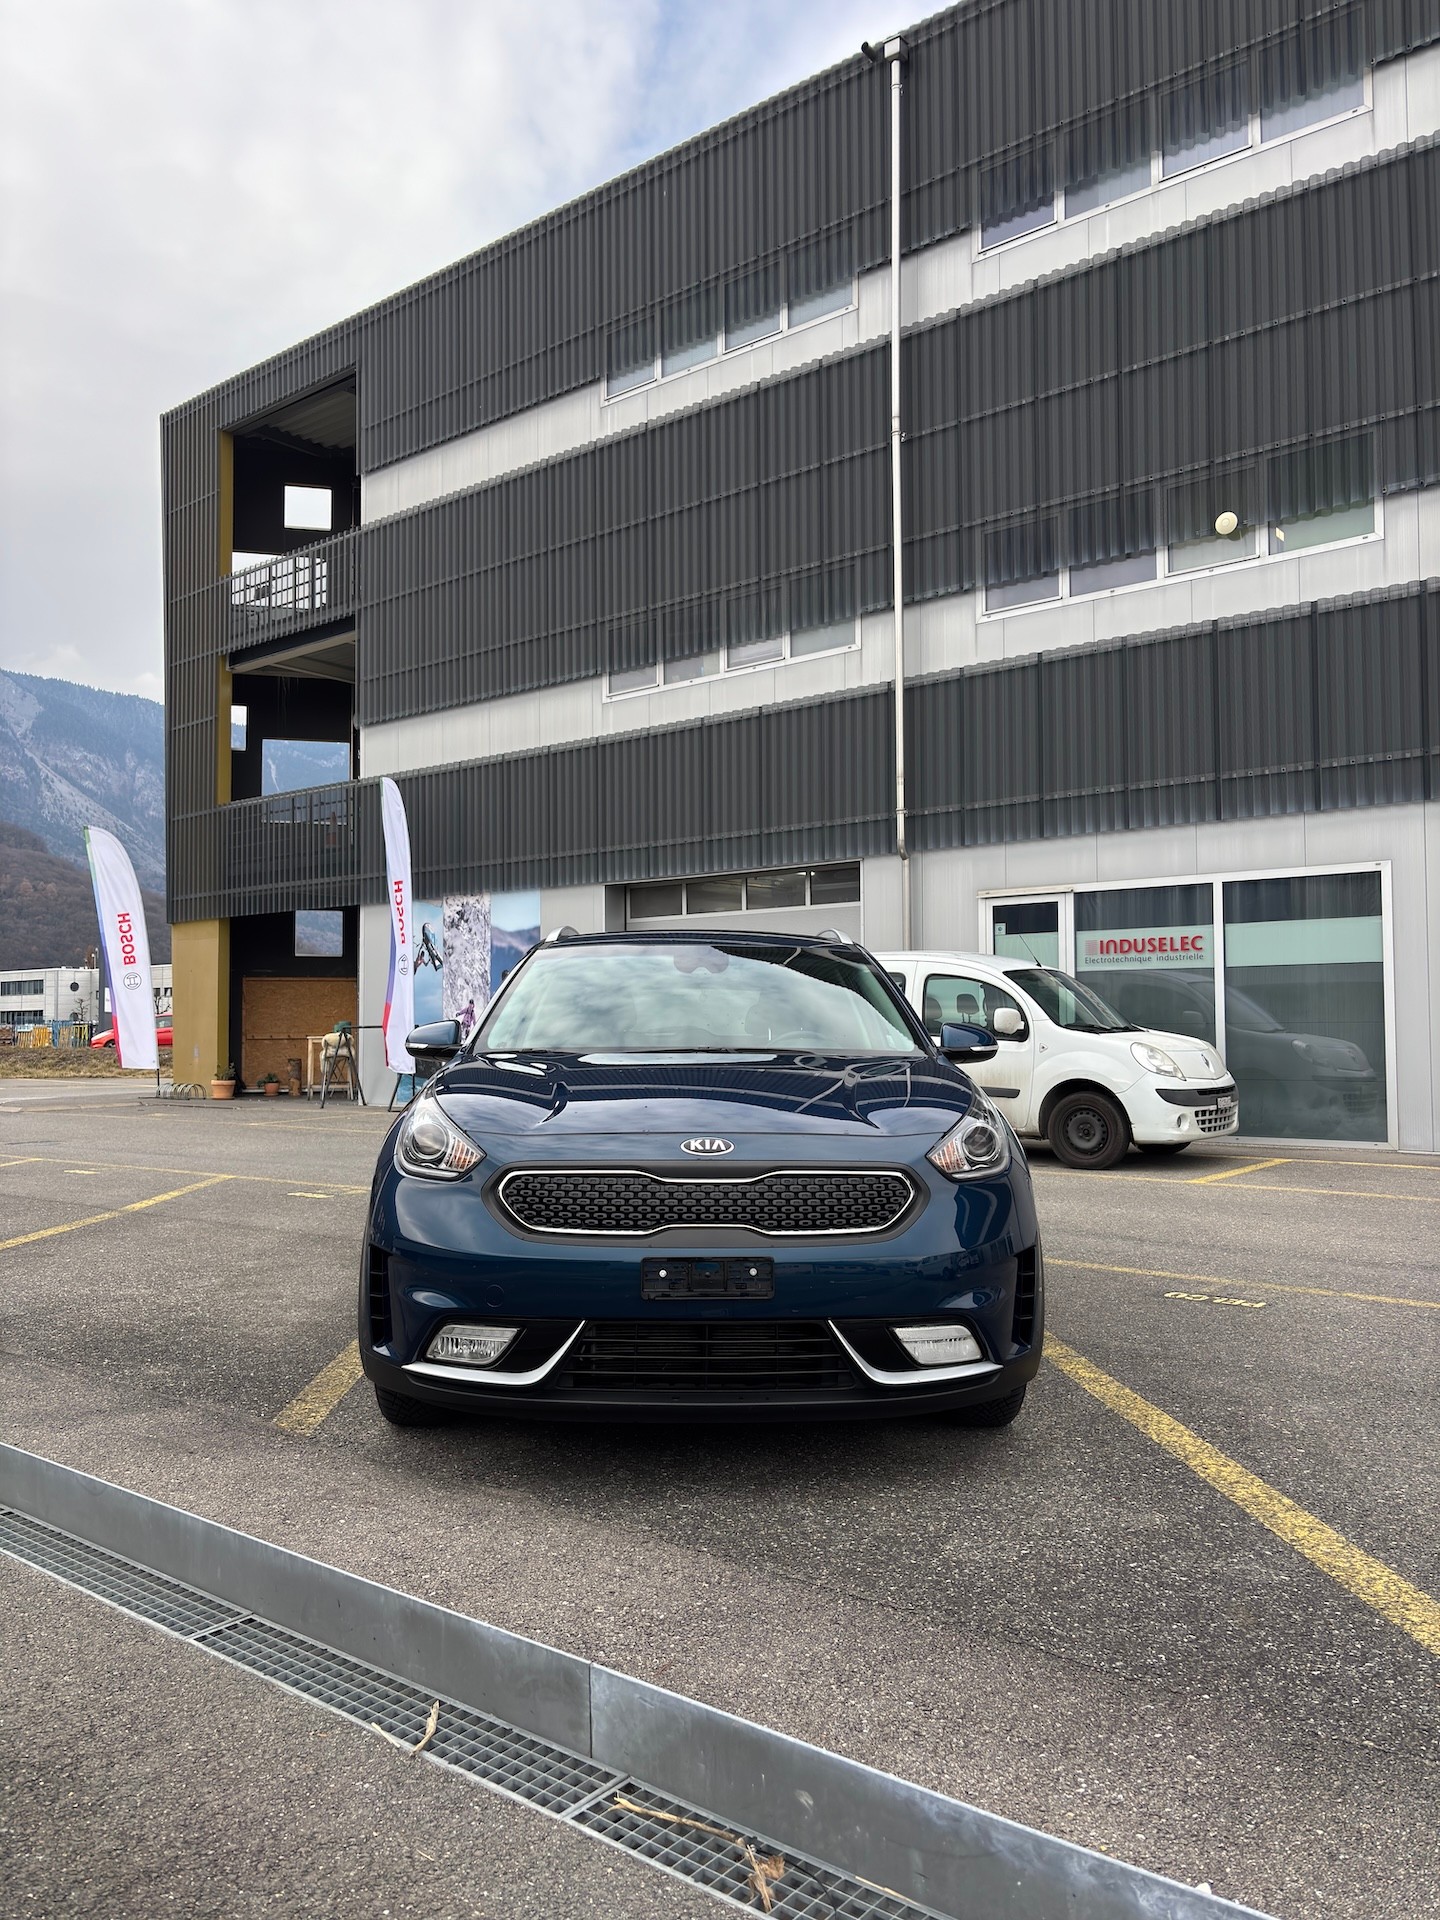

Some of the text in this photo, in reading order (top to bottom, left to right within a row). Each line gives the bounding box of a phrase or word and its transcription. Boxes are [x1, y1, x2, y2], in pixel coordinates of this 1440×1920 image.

[1100, 935, 1203, 955] INDUSELEC
[1085, 953, 1204, 964] Electrotechnique industrielle
[690, 1139, 726, 1151] KIA
